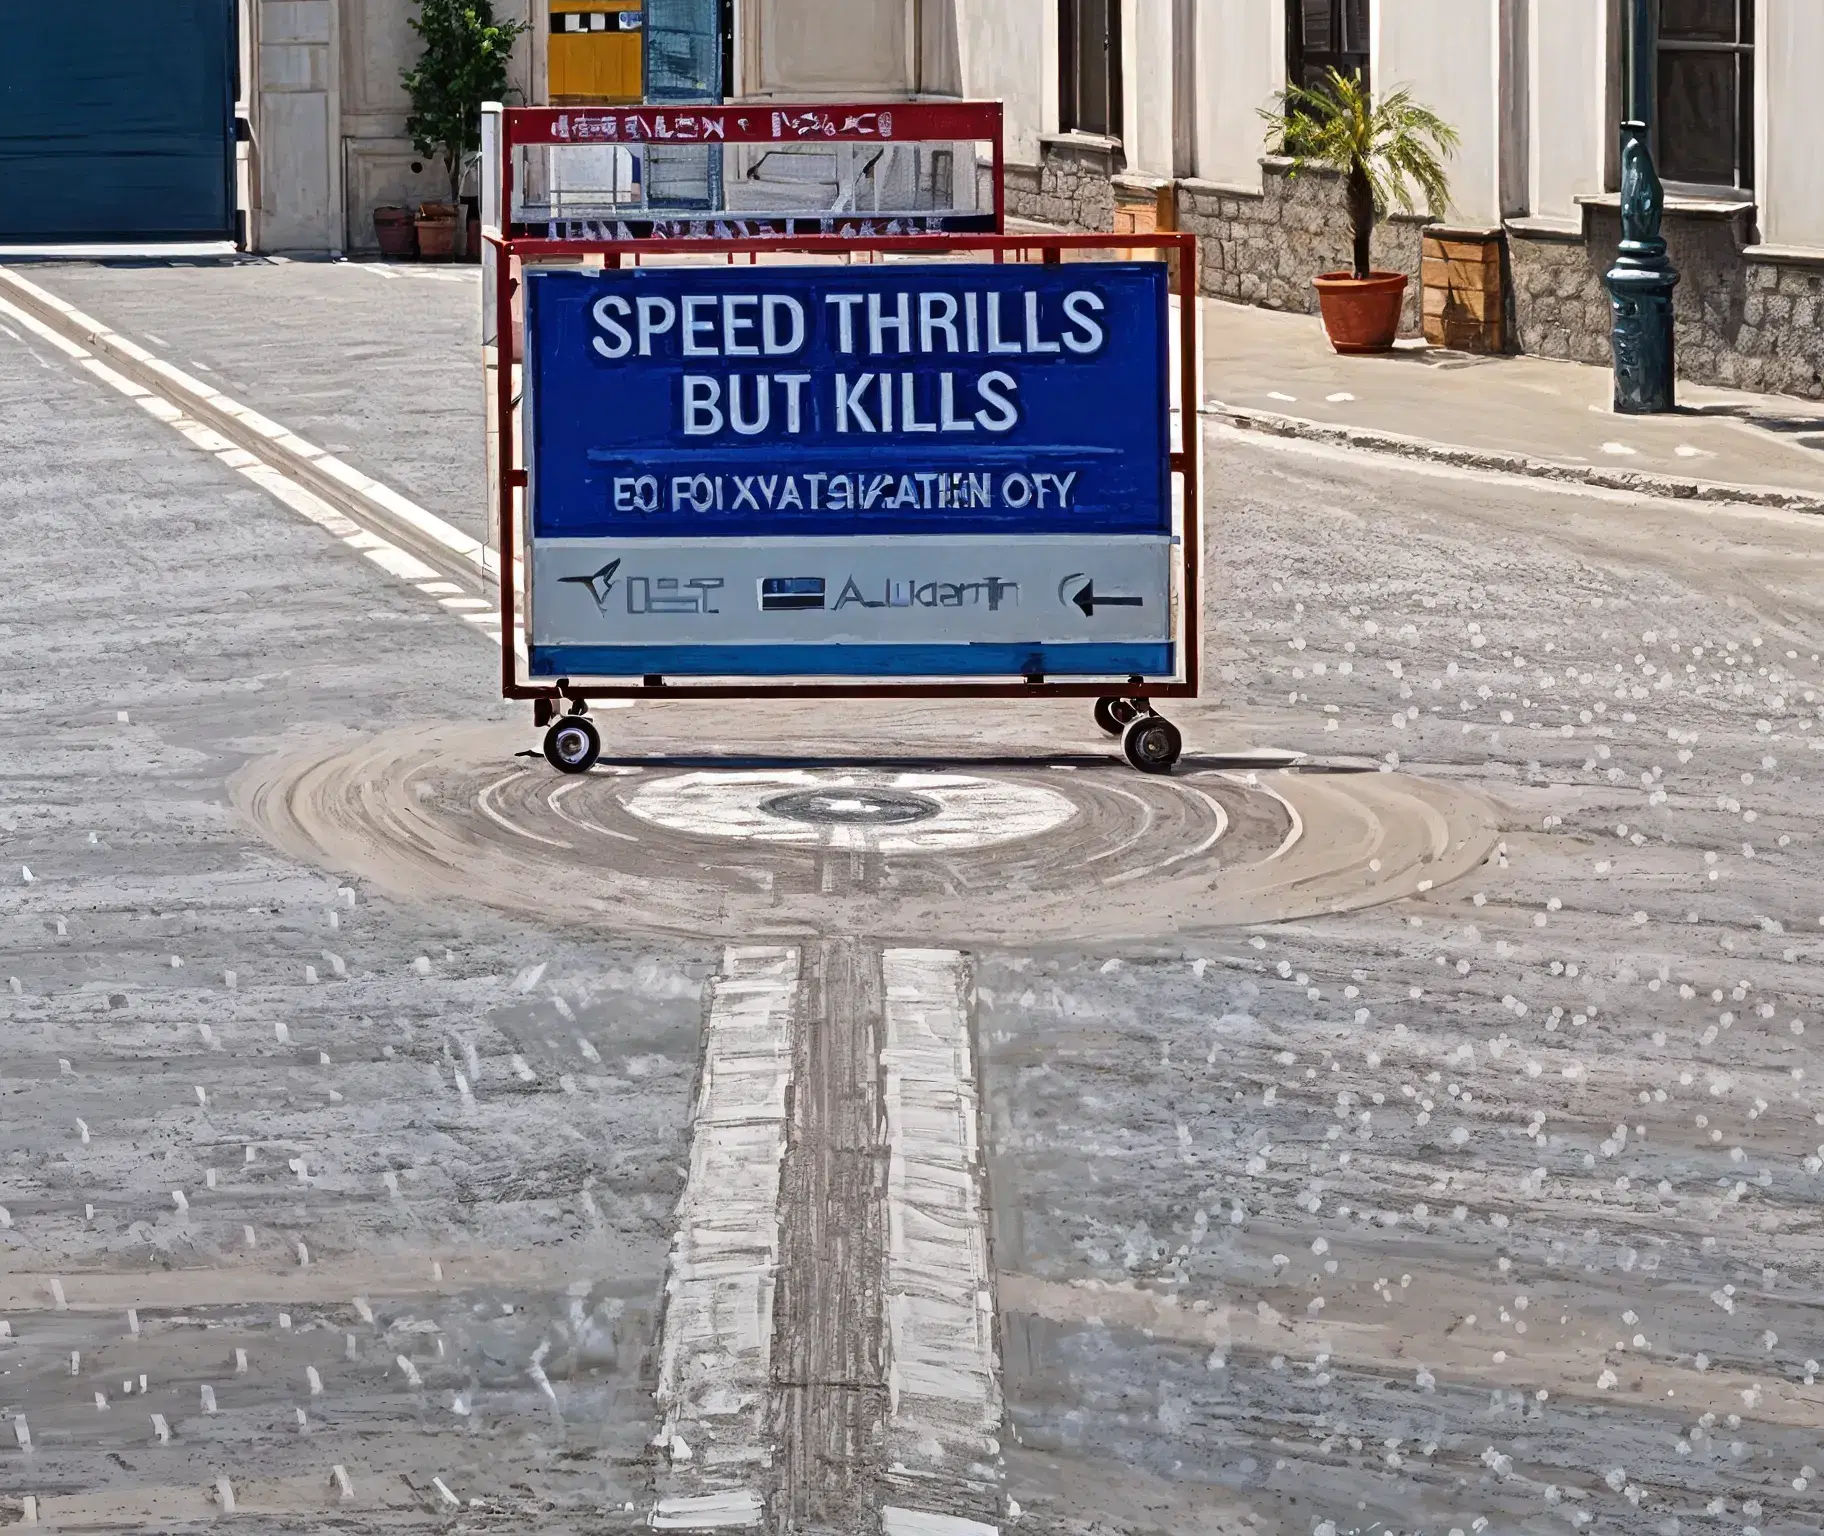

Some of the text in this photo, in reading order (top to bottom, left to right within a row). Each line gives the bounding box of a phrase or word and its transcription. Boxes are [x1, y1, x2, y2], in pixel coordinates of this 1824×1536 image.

[592, 290, 1105, 359] SPEED THRILLS
[683, 370, 1018, 435] BUT KILLS
